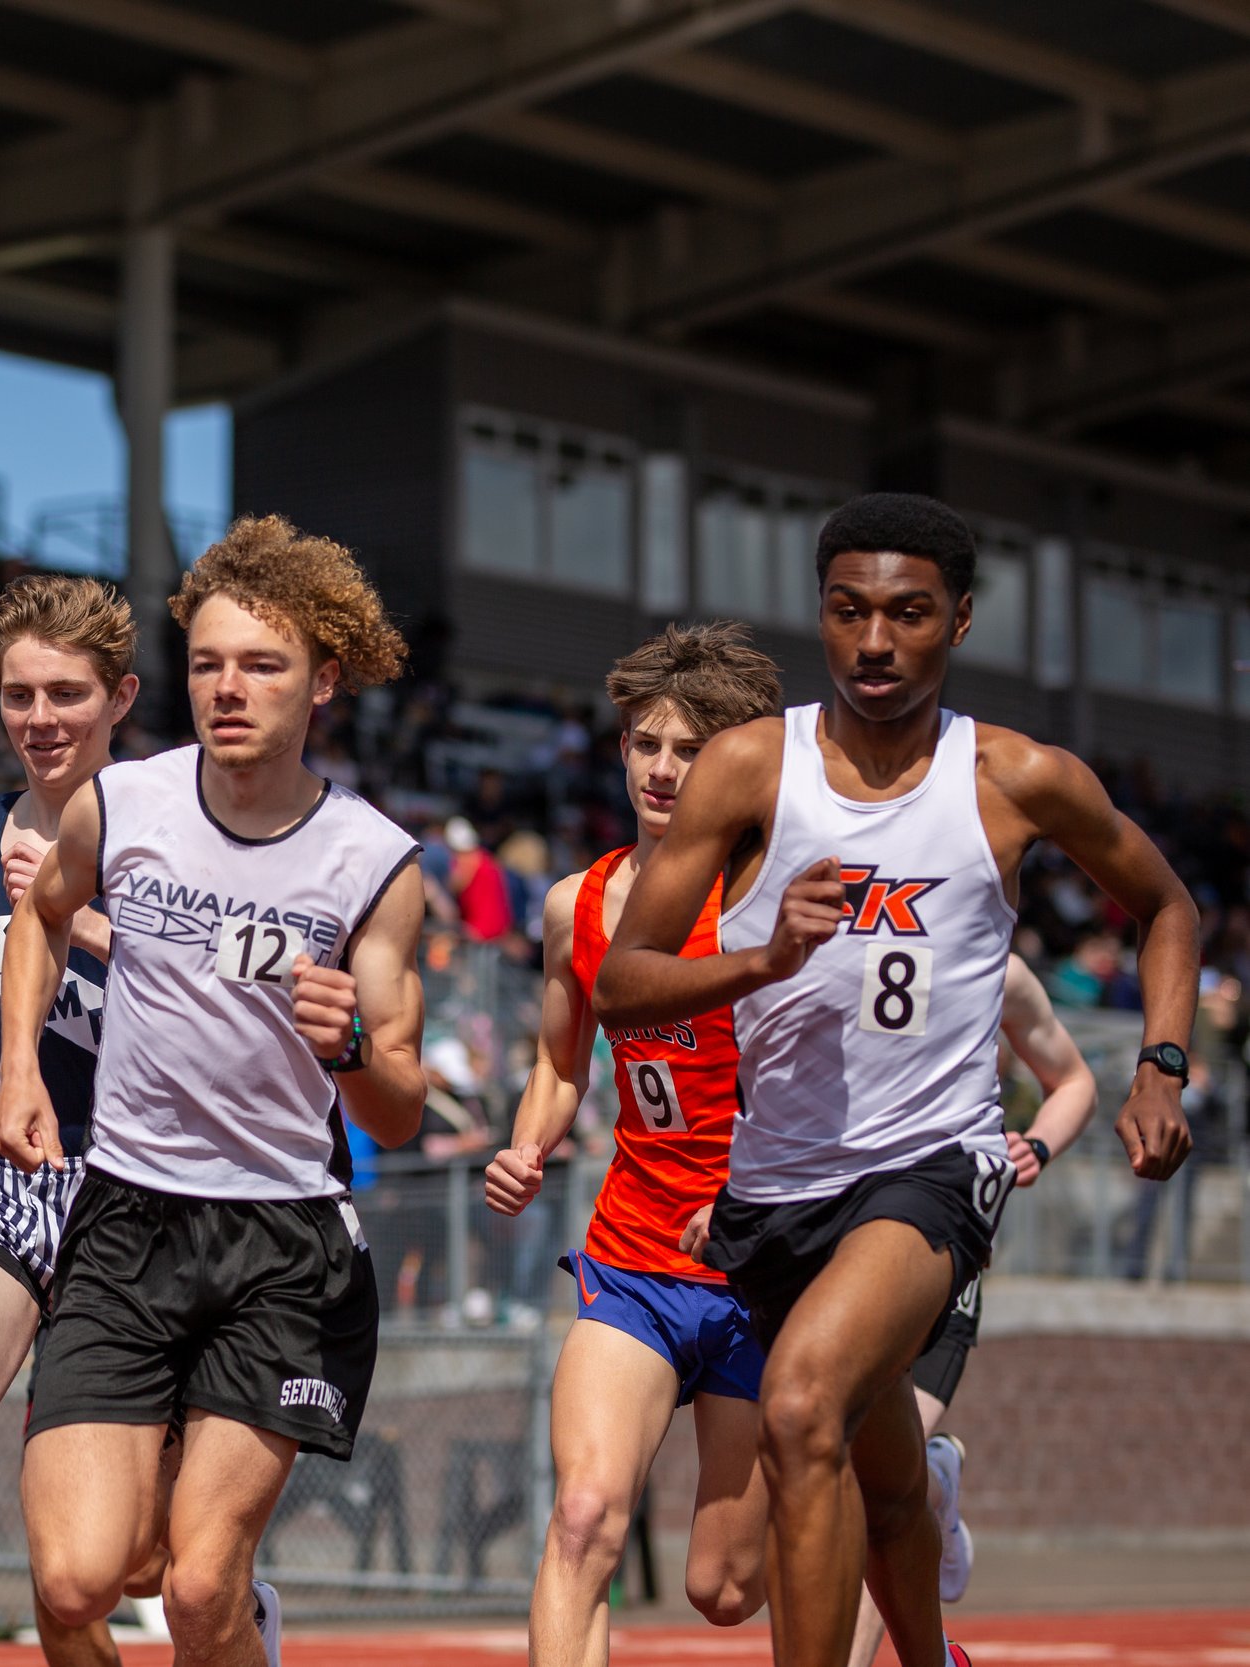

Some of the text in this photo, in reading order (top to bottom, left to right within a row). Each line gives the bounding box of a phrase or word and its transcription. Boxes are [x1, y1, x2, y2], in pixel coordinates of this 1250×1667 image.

[235, 924, 287, 983] 12
[873, 951, 916, 1030] 8
[637, 1063, 673, 1129] 9
[279, 1378, 347, 1424] SENTINELS
